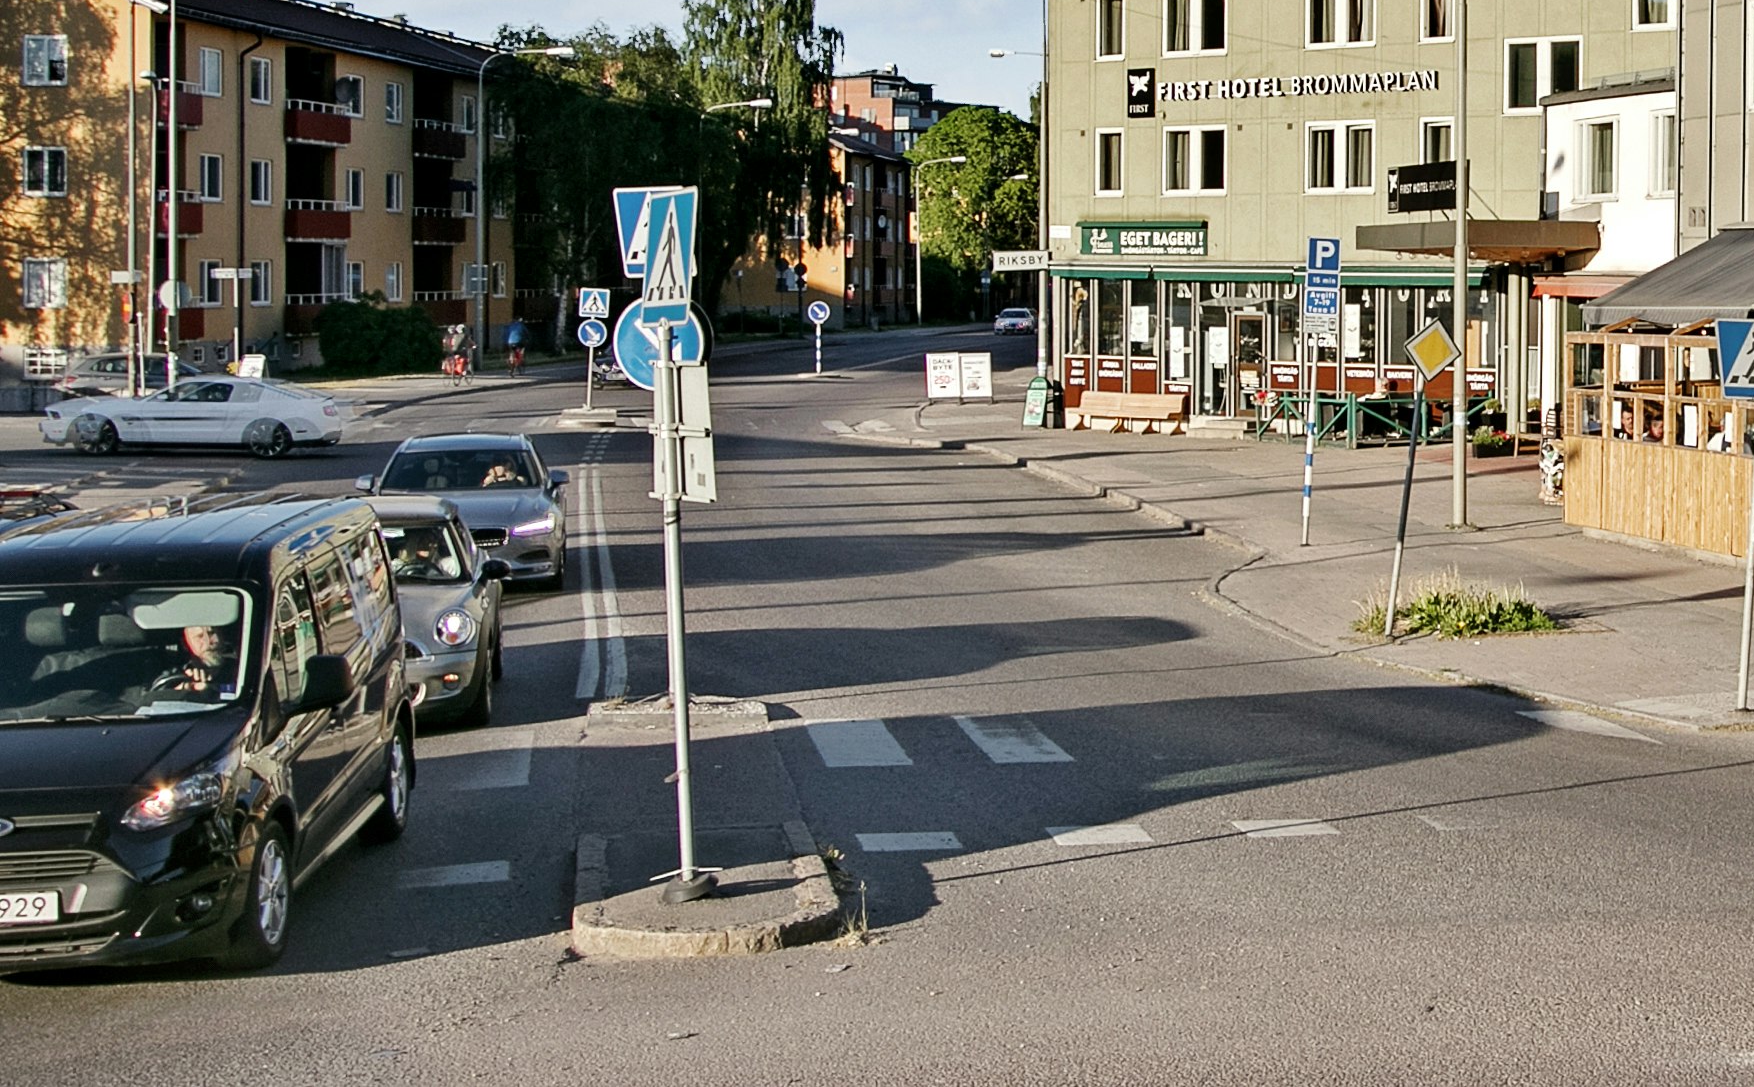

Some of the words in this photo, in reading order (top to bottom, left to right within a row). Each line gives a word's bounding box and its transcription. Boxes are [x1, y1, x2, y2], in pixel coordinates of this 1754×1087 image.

[1157, 80, 1209, 101] FIRST
[1217, 77, 1283, 98] HOTEL
[1290, 70, 1438, 95] BROMMAPLAN
[1129, 104, 1149, 113] FIRST
[1120, 232, 1151, 245] EGET
[1153, 232, 1196, 245] BAGERI
[1315, 240, 1336, 268] P
[999, 255, 1044, 266] RIKSBY
[1322, 276, 1336, 284] min
[1309, 291, 1335, 300] Avgift
